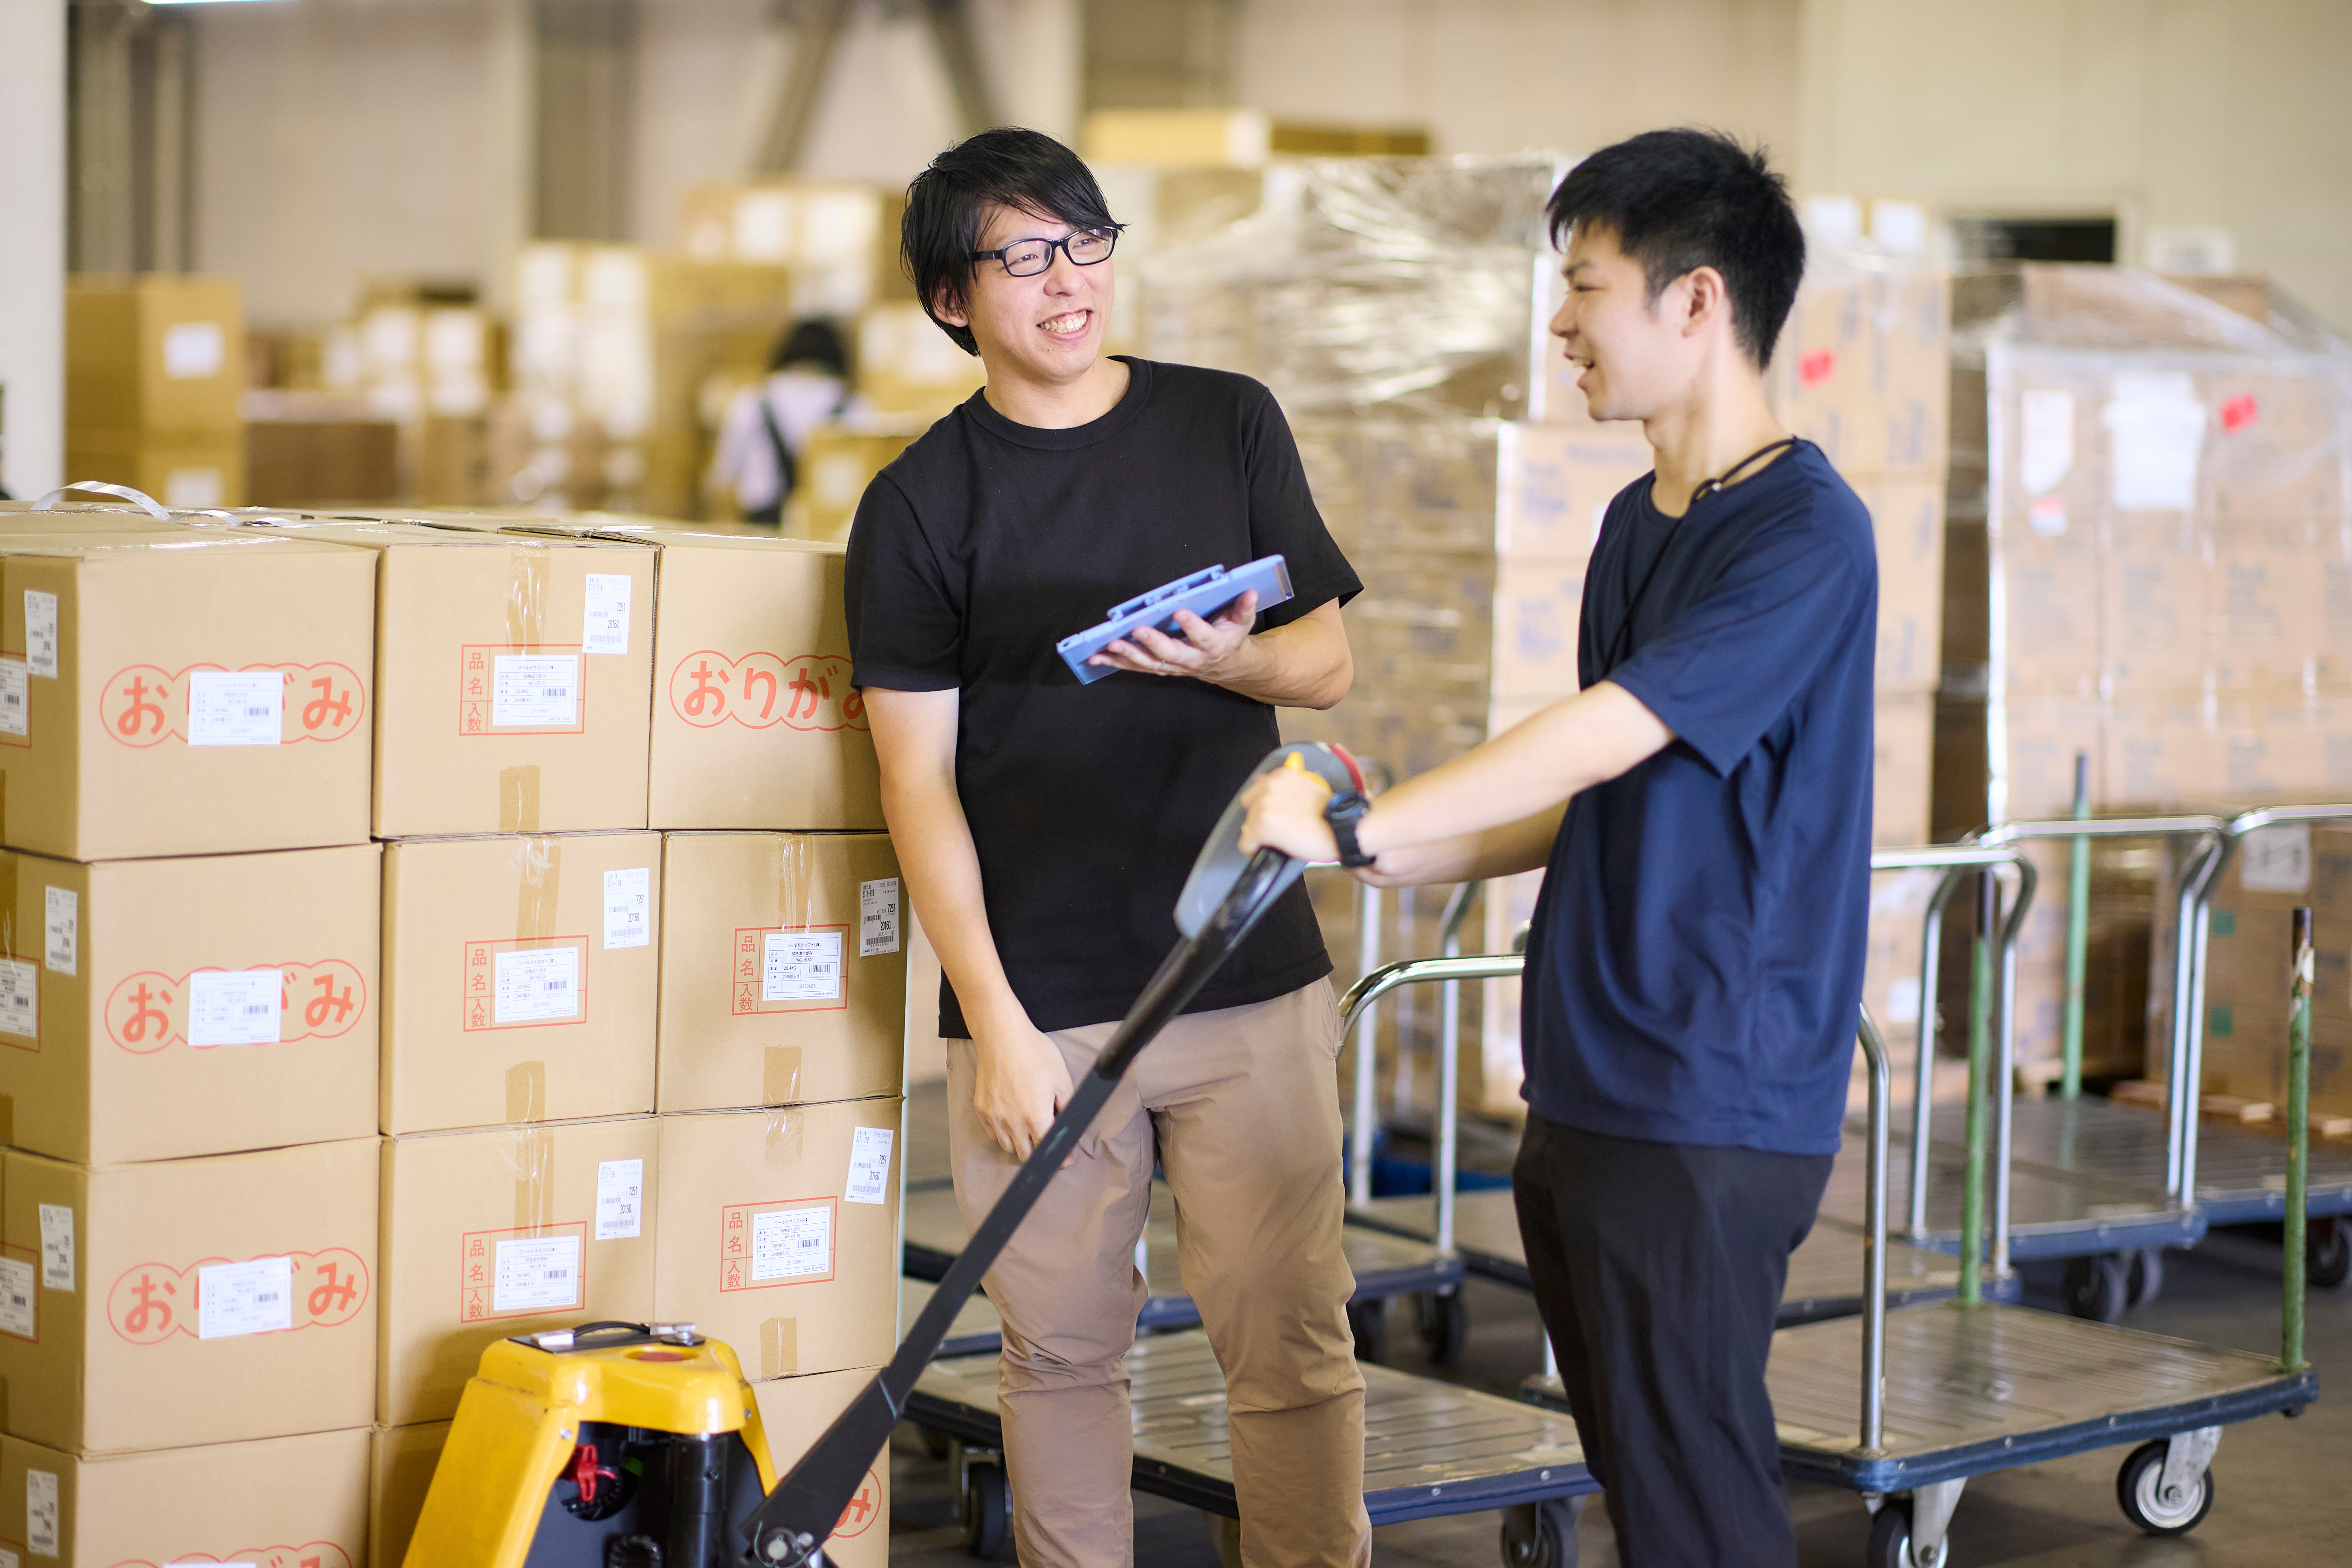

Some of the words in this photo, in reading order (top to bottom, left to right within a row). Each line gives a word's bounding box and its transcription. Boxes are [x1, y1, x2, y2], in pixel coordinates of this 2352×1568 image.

[617, 602, 626, 611] 7251
[608, 620, 619, 628] 20160
[468, 652, 483, 695] 品名
[117, 676, 352, 736] おみ
[467, 703, 482, 731] 入数
[636, 895, 645, 904] 7251
[628, 912, 639, 922] 20160
[881, 921, 891, 930] 20160
[471, 949, 486, 991] 品名
[740, 936, 755, 976] 品名
[123, 972, 354, 1043] おみ
[739, 984, 753, 1011] 入数
[471, 999, 485, 1027] 入数
[869, 1171, 879, 1180] 20160
[629, 1186, 637, 1196] 7251
[620, 1204, 631, 1214] 20160
[728, 1212, 743, 1253] 品名
[469, 1239, 484, 1282] 品名
[727, 1261, 741, 1288] 入数
[125, 1261, 357, 1333] おみ
[469, 1290, 482, 1318] 入数
